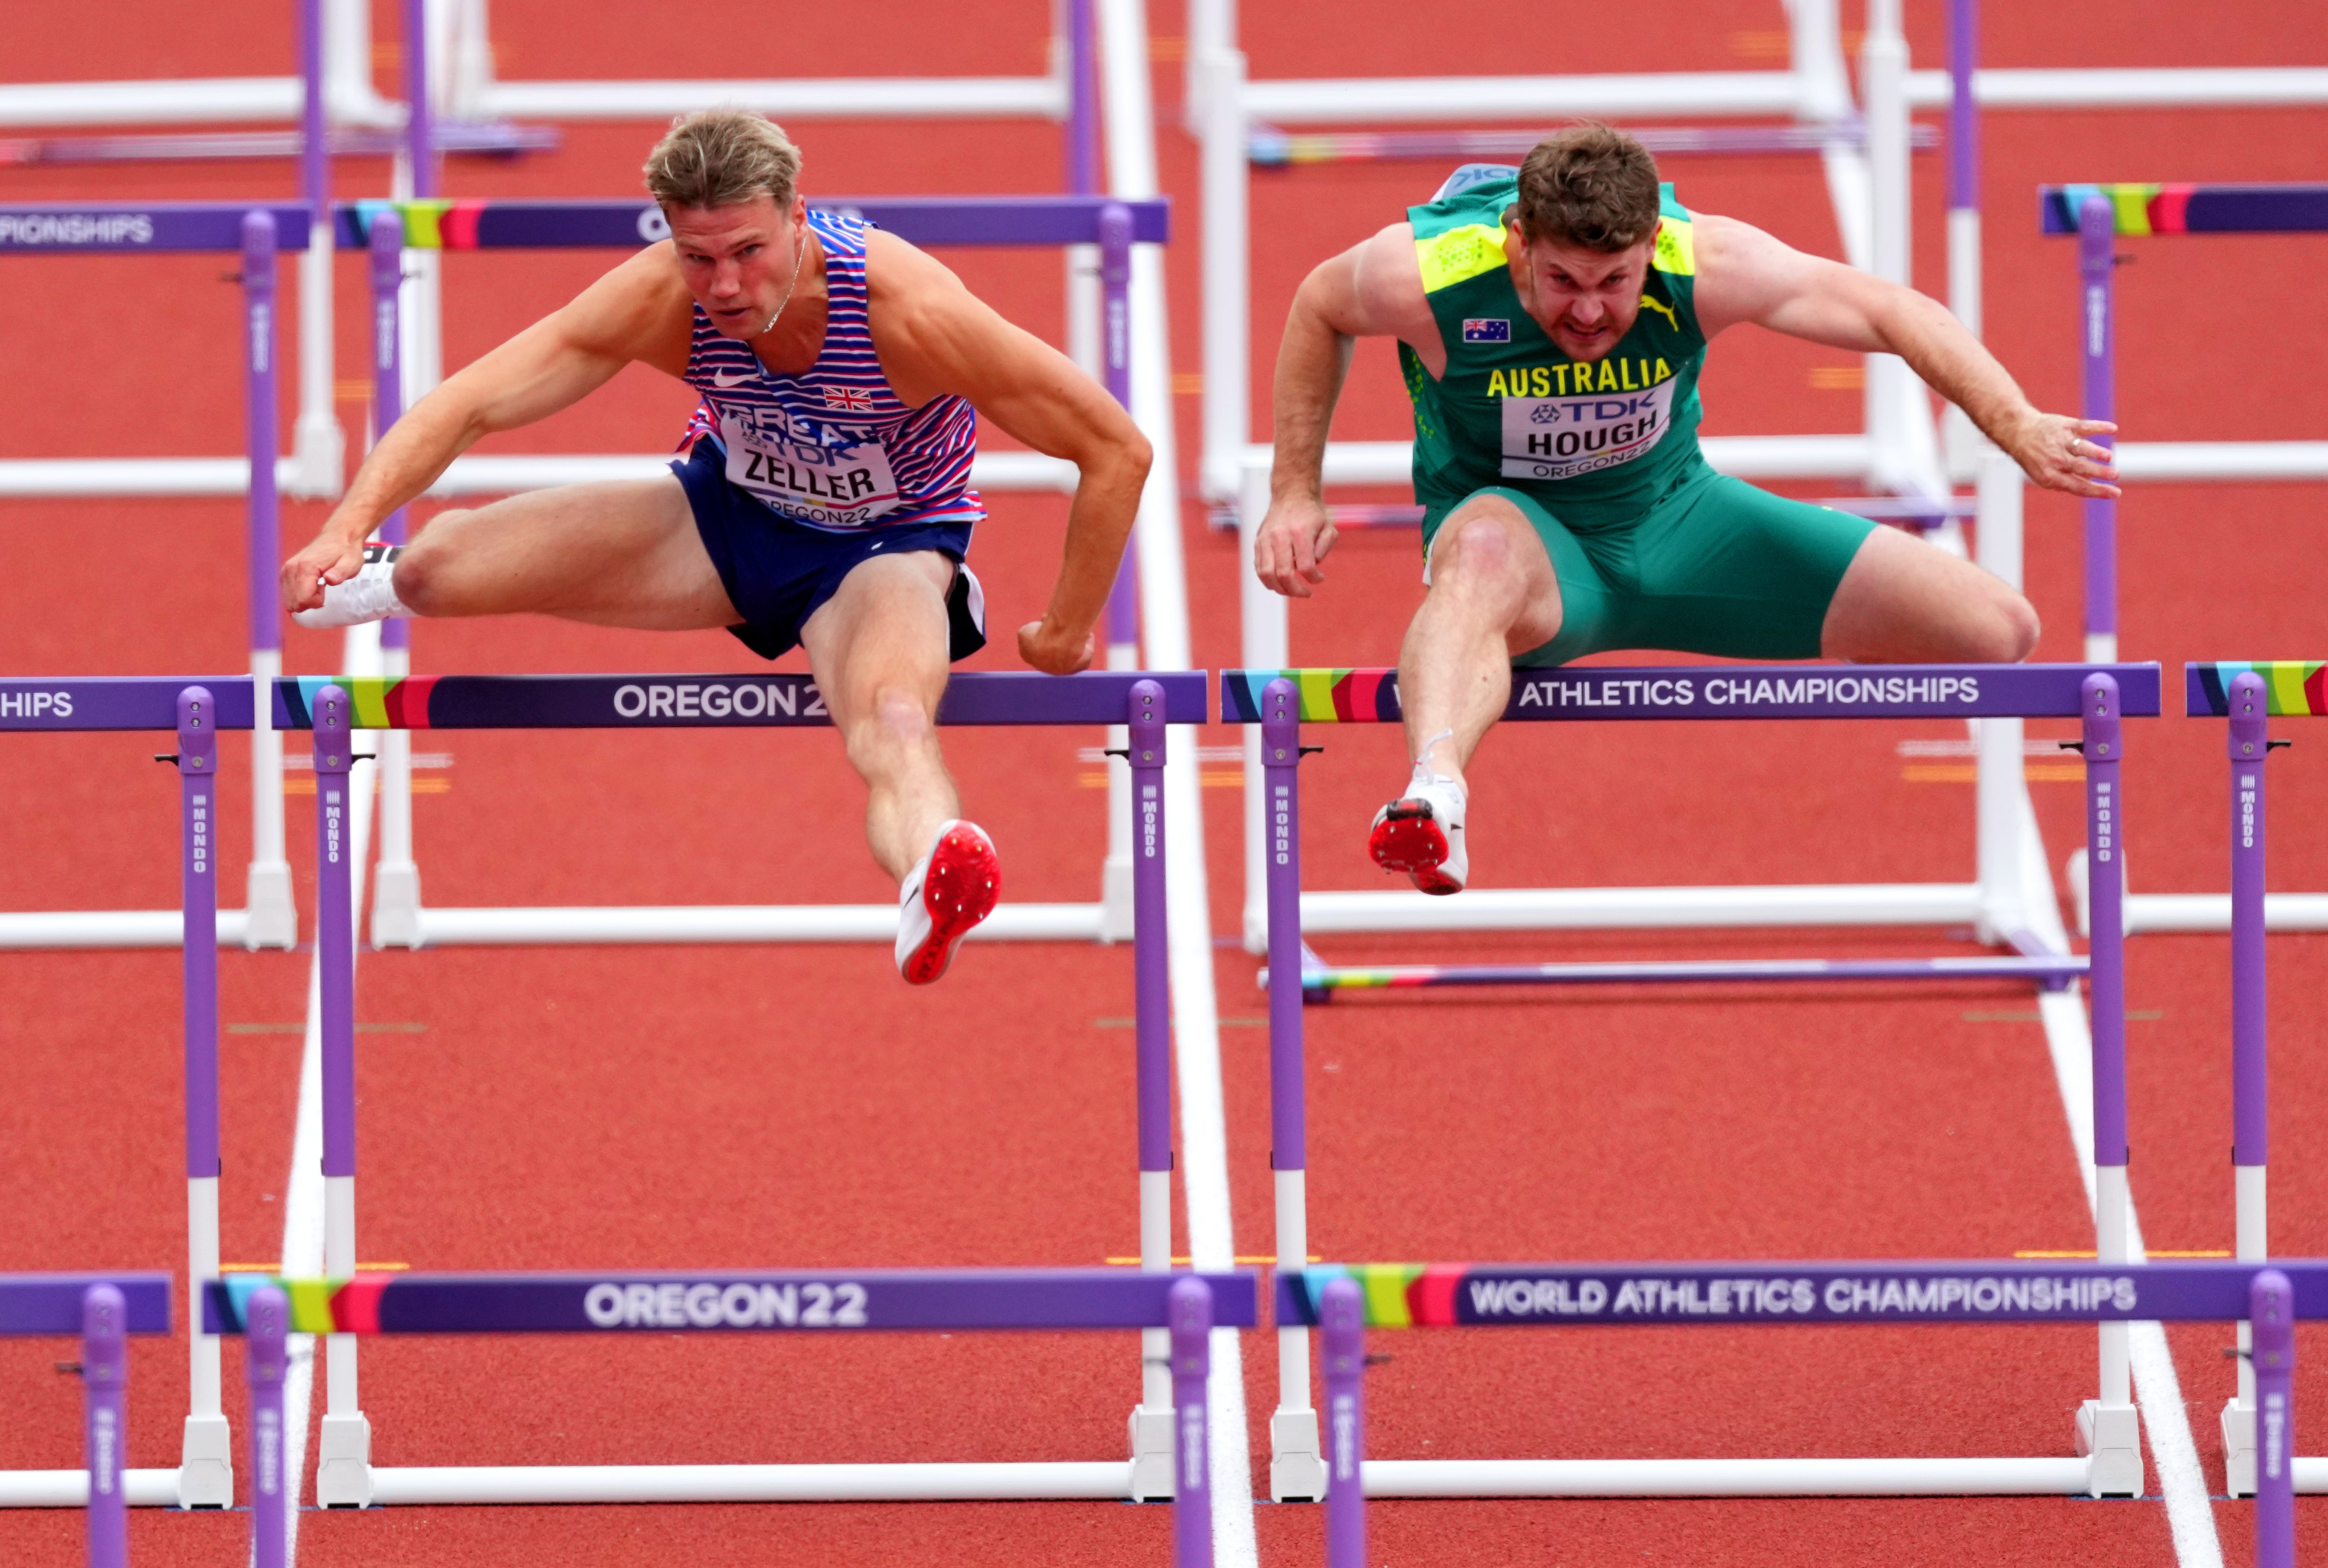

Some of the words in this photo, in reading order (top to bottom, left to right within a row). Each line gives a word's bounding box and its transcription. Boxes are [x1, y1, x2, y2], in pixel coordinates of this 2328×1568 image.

[1486, 357, 1672, 397] AUSTRALIA
[1561, 389, 1656, 423] TDK
[1528, 410, 1657, 457] HOUGH
[745, 448, 876, 501] ZELLER
[1533, 440, 1650, 478] OREGON22
[1519, 679, 1695, 707] ATHLETICS
[1704, 676, 1980, 705] CHAMPIONSHIPS
[193, 808, 207, 873] MONDO
[326, 807, 341, 863] MONDO
[1143, 801, 1157, 858] MONDO
[1275, 799, 1289, 864] MONDO
[2096, 796, 2112, 862] MONDO
[2240, 790, 2256, 848] MONDO
[584, 1282, 869, 1327] OREGON22
[1470, 1279, 1608, 1316] WORLD
[1613, 1278, 1815, 1314] ATHLETICS
[1824, 1276, 2137, 1313] CHAMPIONSHIPS
